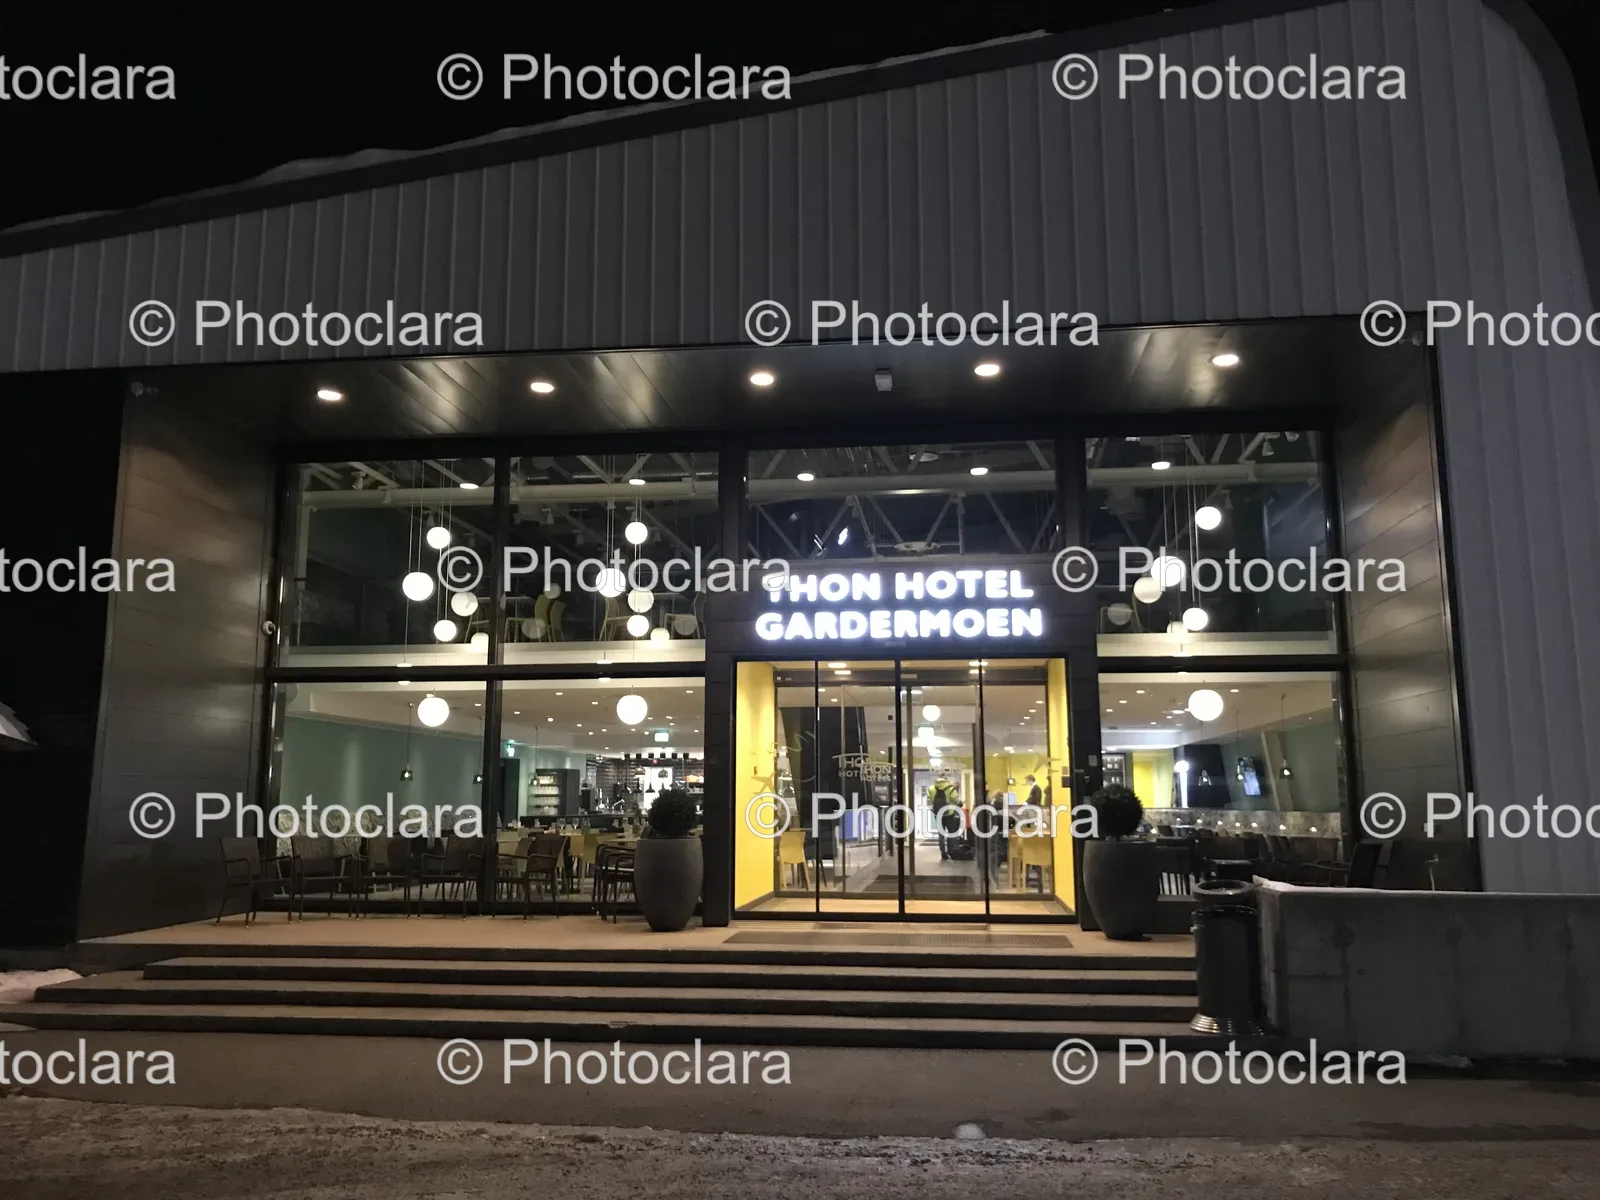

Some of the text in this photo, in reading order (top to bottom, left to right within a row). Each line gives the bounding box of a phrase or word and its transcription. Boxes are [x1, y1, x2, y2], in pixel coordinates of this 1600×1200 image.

[763, 570, 1034, 602] THON HOTEL
[756, 608, 1043, 641] GARDERMOEN
